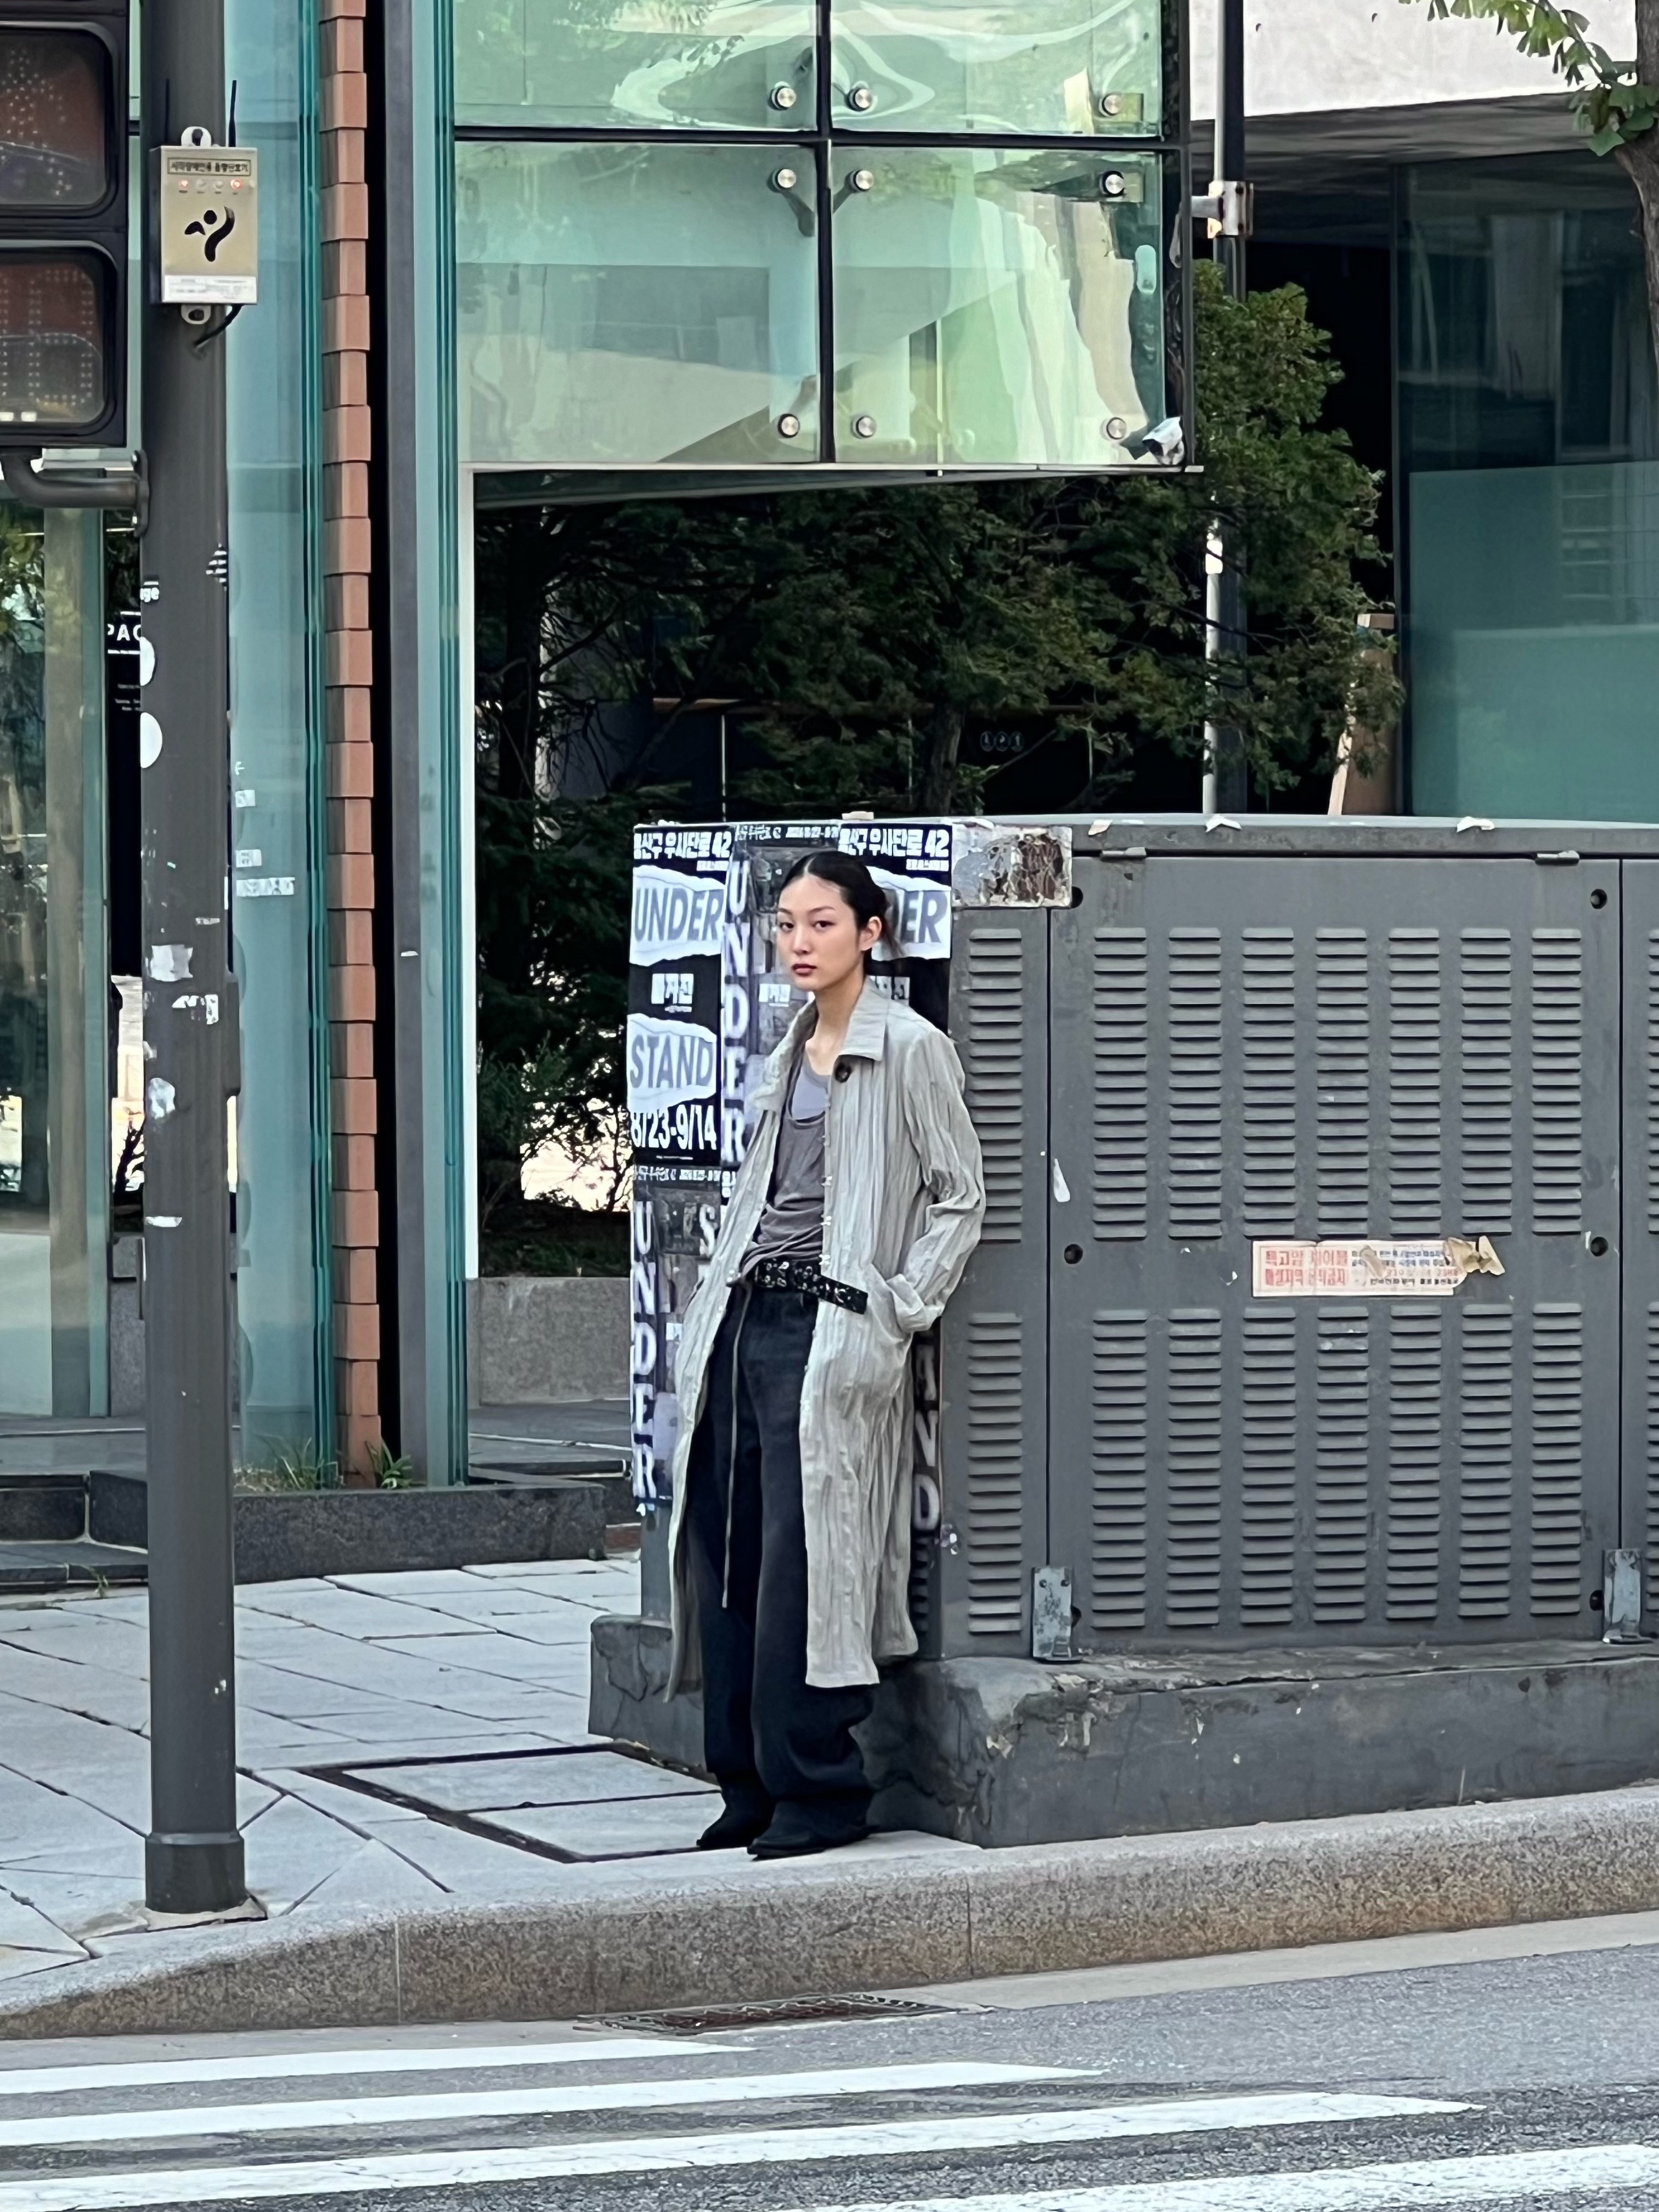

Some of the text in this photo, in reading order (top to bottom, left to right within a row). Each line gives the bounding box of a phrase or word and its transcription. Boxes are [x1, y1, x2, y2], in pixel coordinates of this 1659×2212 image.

[712, 831, 732, 858] 42
[924, 829, 950, 858] 42
[633, 887, 724, 942] UNDER
[630, 1034, 713, 1088] STAND
[633, 1201, 657, 1498] UNDER
